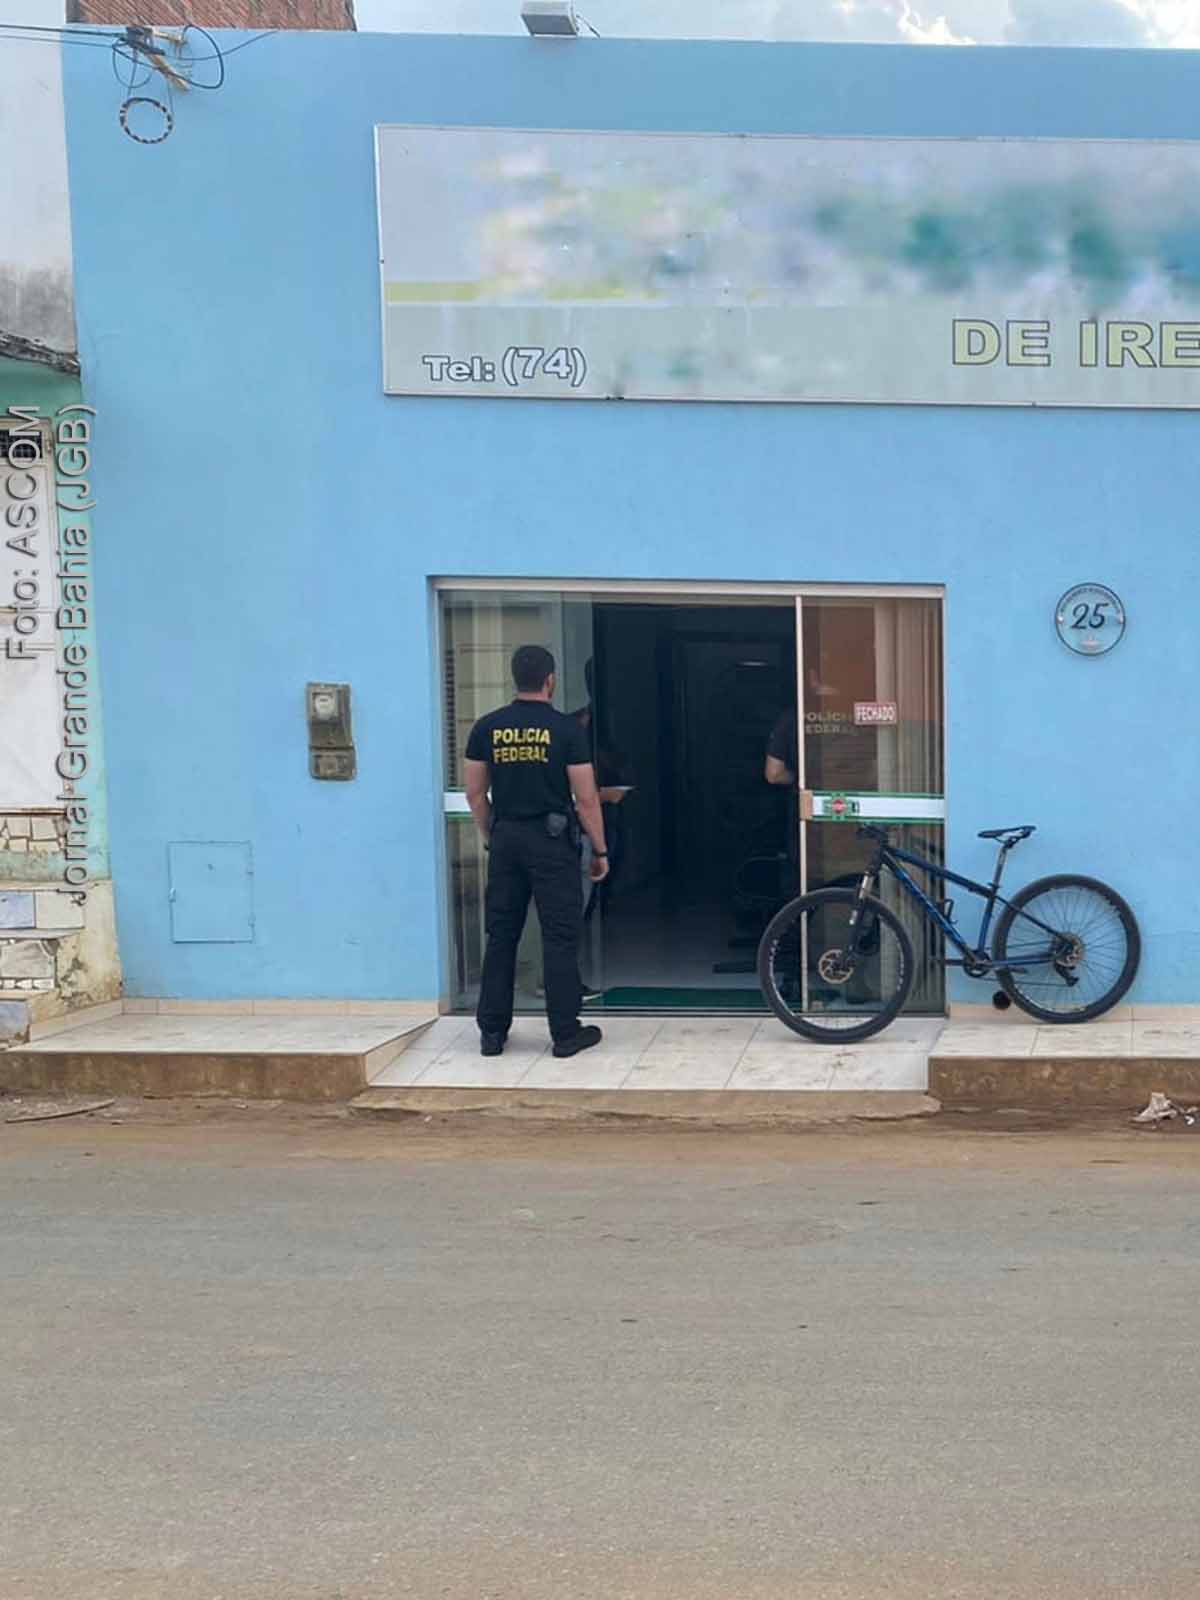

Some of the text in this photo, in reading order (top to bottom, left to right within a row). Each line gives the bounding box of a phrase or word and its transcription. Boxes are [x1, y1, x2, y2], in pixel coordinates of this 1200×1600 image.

[951, 318, 1050, 366] DE
[422, 346, 588, 388] Tel: (74)
[1070, 602, 1110, 630] 25
[856, 705, 896, 721] FECHADO
[492, 727, 551, 745] POLICIA
[493, 746, 549, 764] FEDERAL
